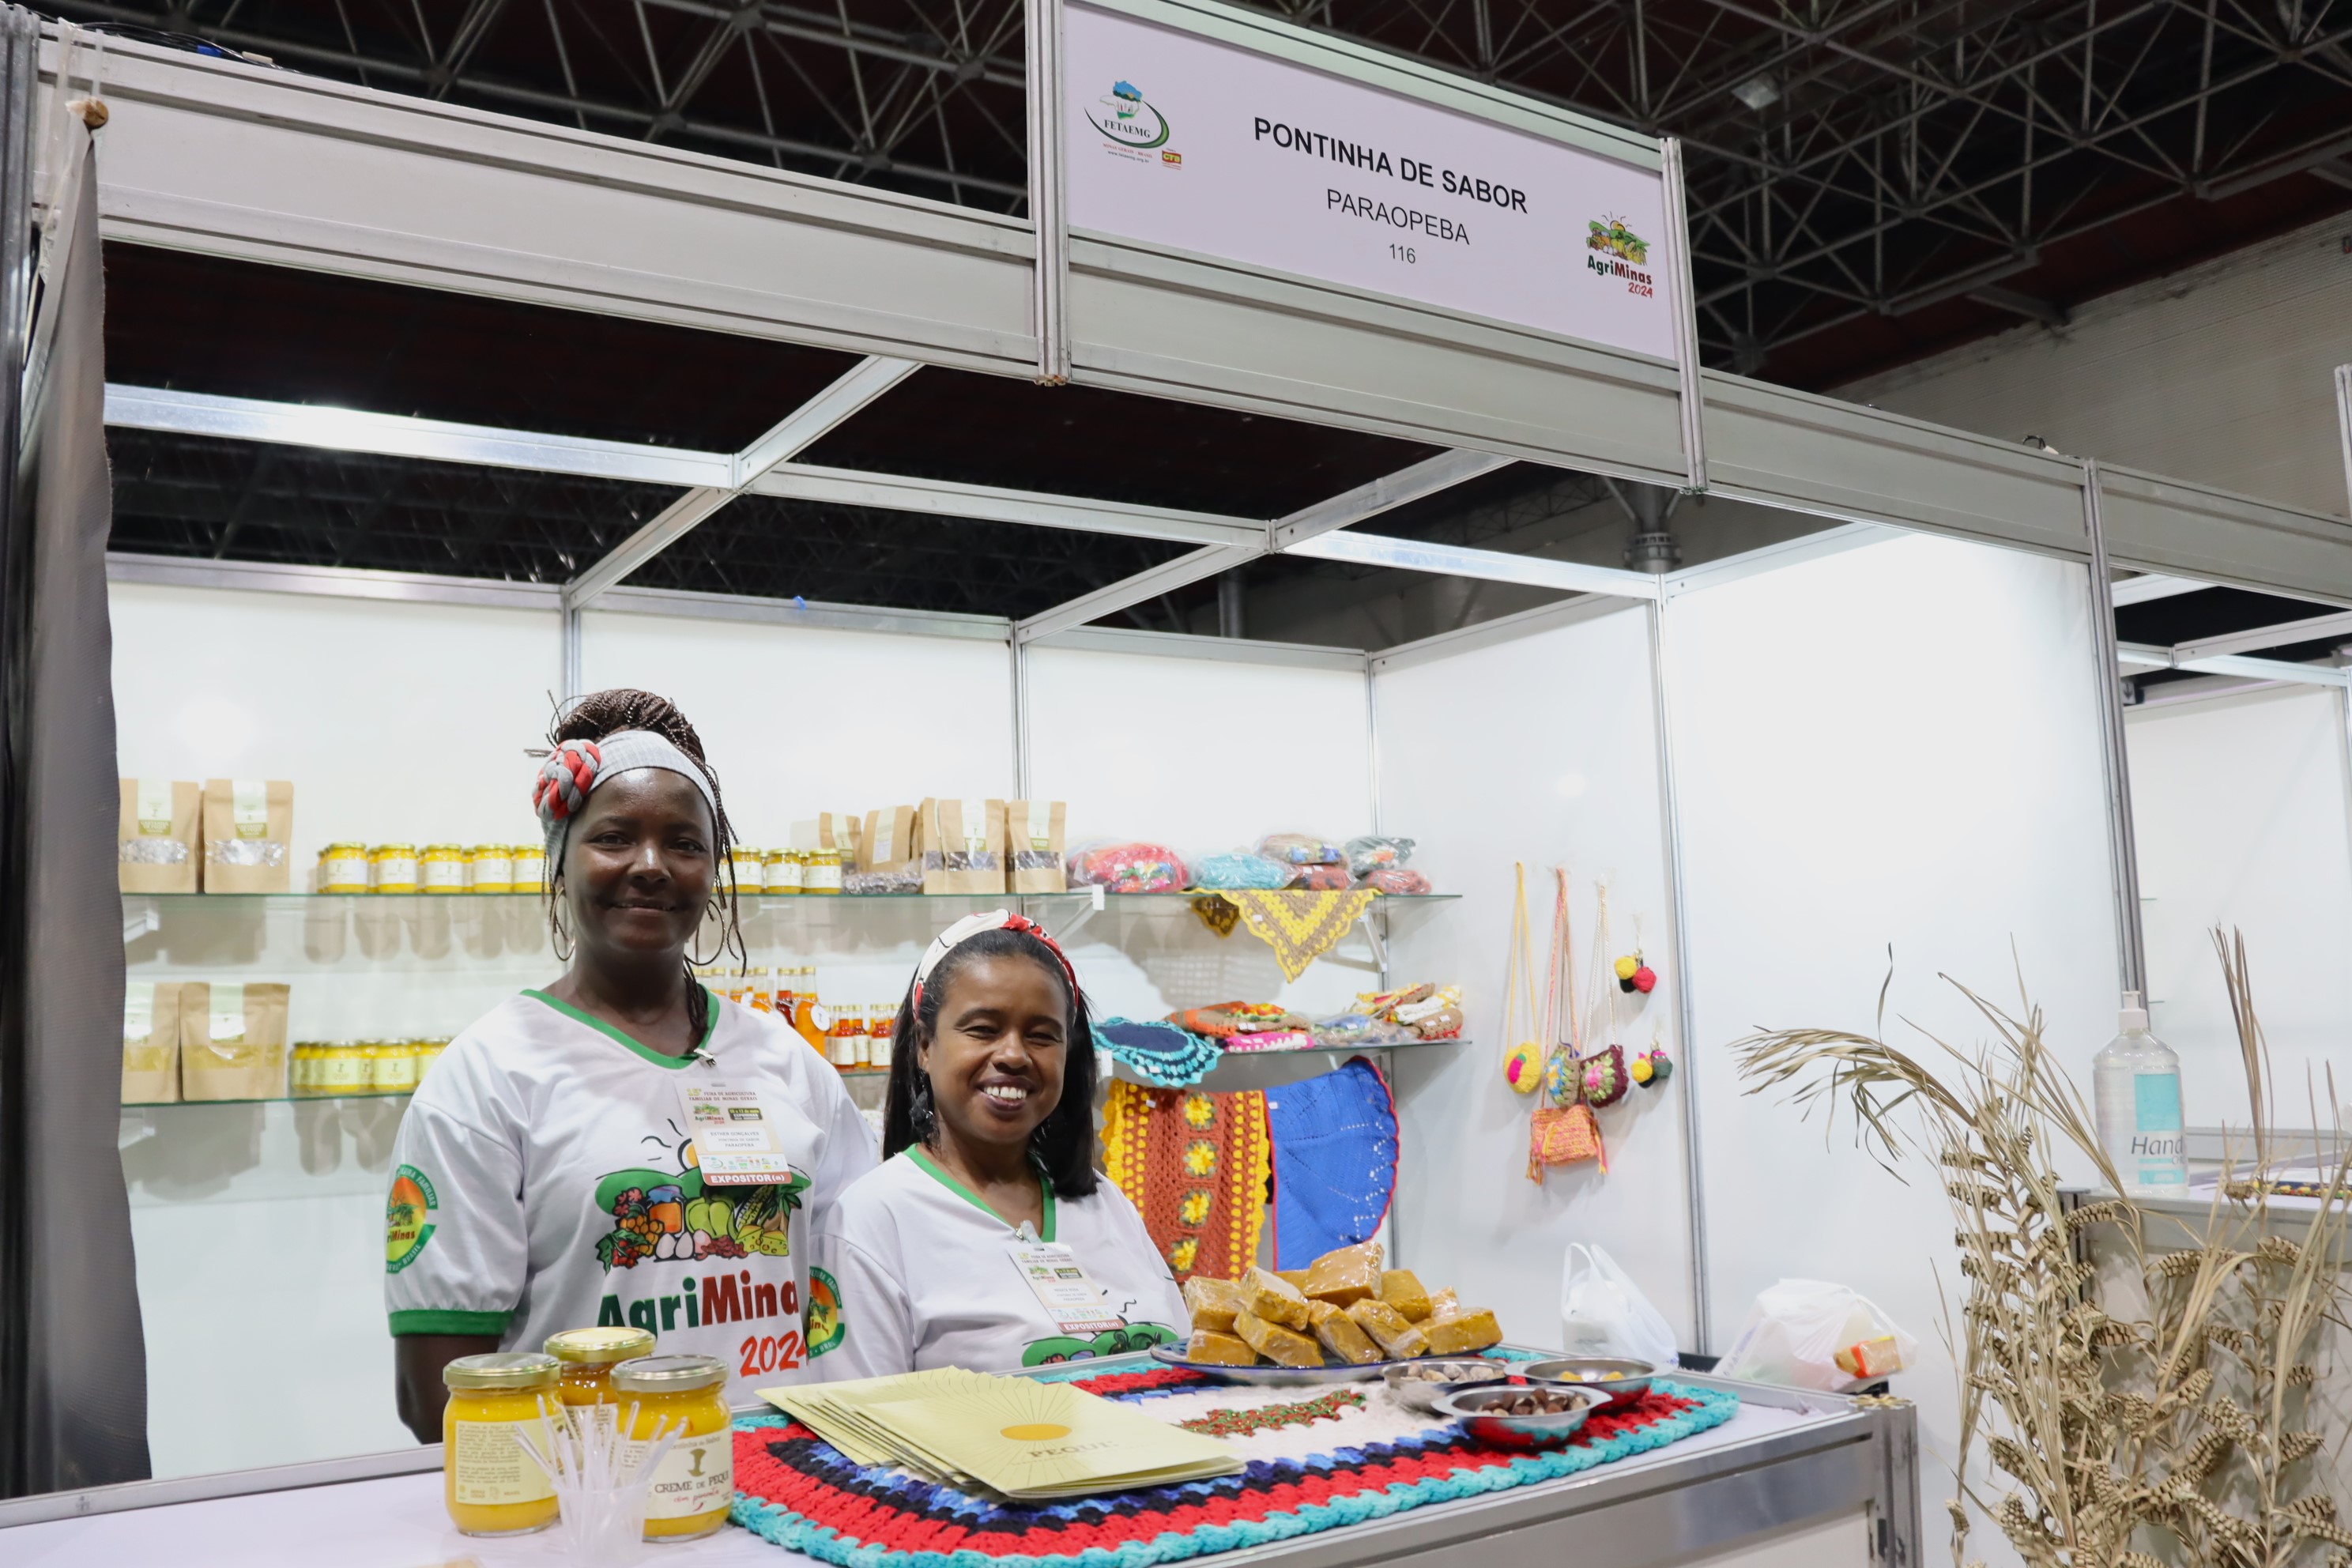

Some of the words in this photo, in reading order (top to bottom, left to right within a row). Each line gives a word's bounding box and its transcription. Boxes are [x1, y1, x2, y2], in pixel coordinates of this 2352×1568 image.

[1104, 119, 1151, 138] FETAEMG
[1254, 117, 1393, 177] PONTINHA
[1400, 157, 1434, 188] DE
[1442, 170, 1528, 213] SABOR
[1328, 188, 1469, 245] PARAOPEBA
[1389, 243, 1415, 264] 116
[1588, 254, 1652, 285] AgriMinas
[1628, 282, 1653, 299] 2024
[2132, 1135, 2183, 1155] Hand
[710, 1174, 785, 1183] EXPOSITOR(a)
[416, 1176, 436, 1206] FAMILIAR
[387, 1230, 415, 1243] riMinas
[597, 1269, 799, 1339] AgriMina
[654, 1481, 692, 1494] CREME
[709, 1470, 729, 1486] PEQUI
